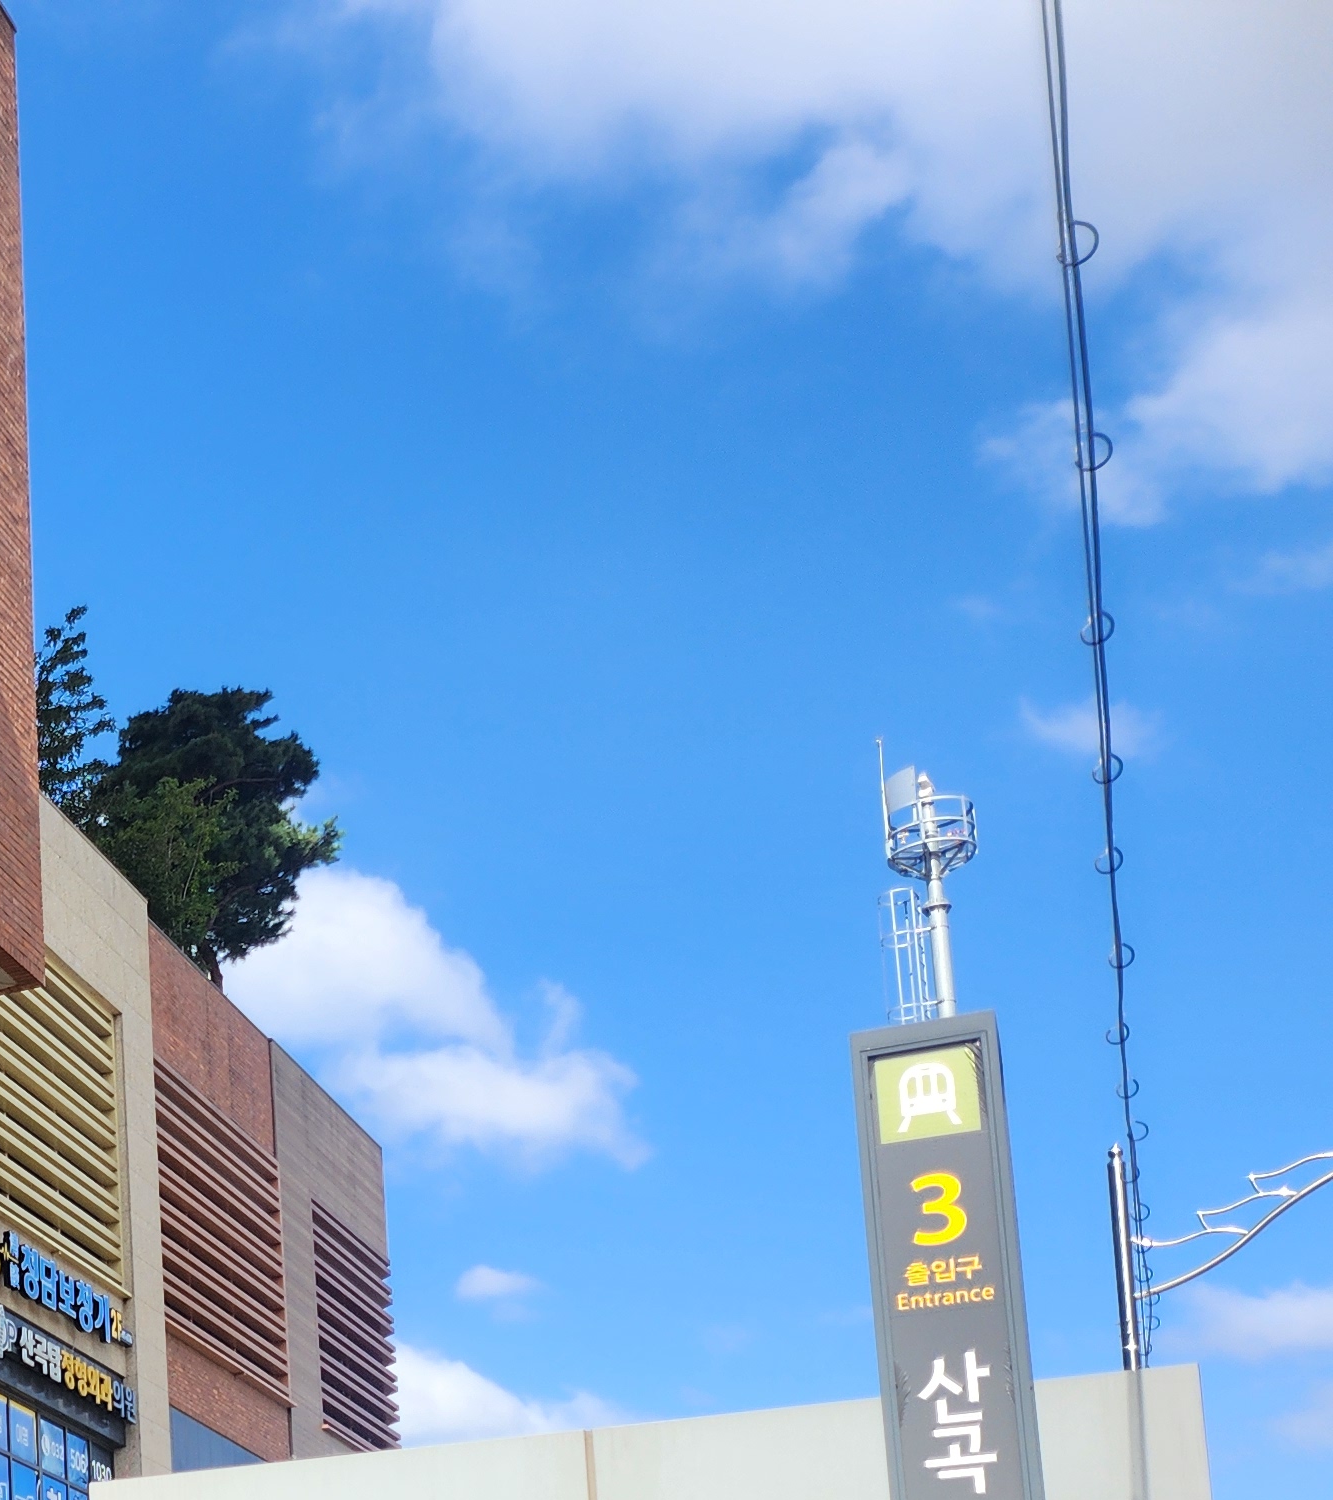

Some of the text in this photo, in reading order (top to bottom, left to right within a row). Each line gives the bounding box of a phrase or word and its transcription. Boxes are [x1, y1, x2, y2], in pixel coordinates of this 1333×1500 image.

[910, 1172, 968, 1246] 3
[20, 1244, 111, 1344] 청담보청기
[896, 1283, 995, 1312] Entrance
[904, 1257, 982, 1287] 출입구
[917, 1348, 998, 1495] 산곡
